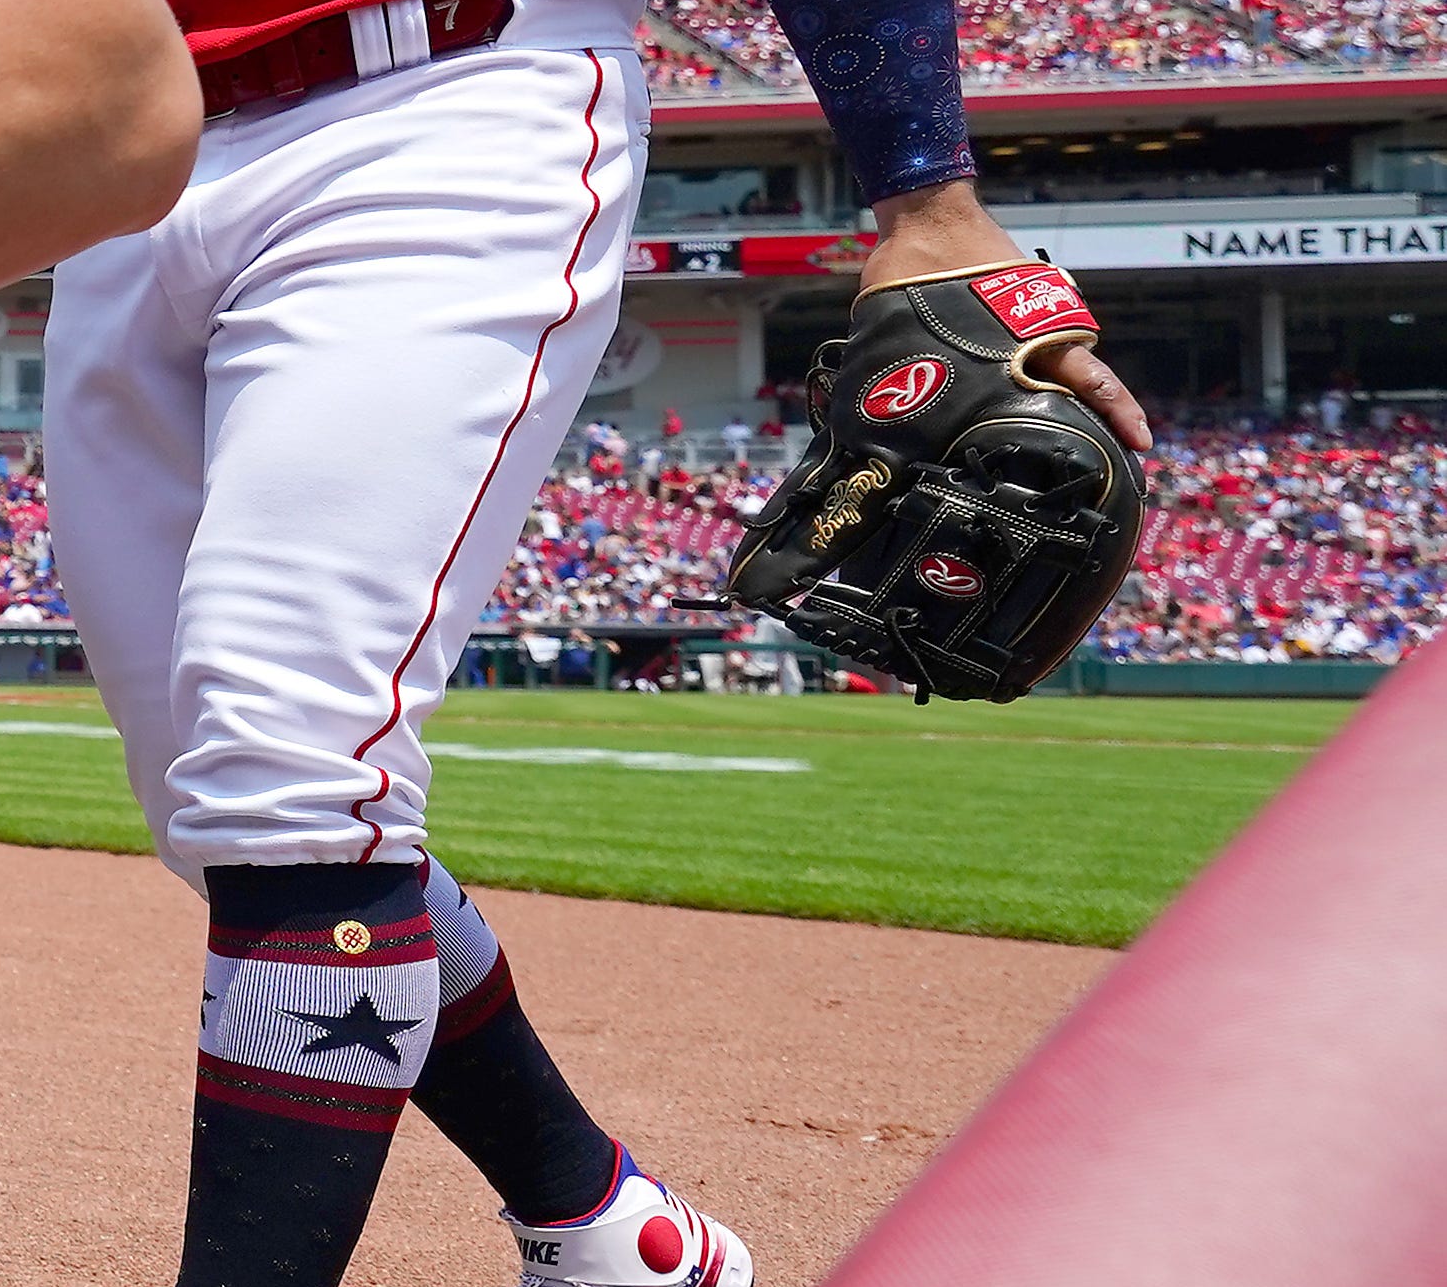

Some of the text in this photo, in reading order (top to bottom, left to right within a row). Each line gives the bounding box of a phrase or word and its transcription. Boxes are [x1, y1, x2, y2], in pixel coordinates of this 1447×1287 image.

[1185, 224, 1447, 258] NAME THAT
[518, 1237, 562, 1267] IKE
